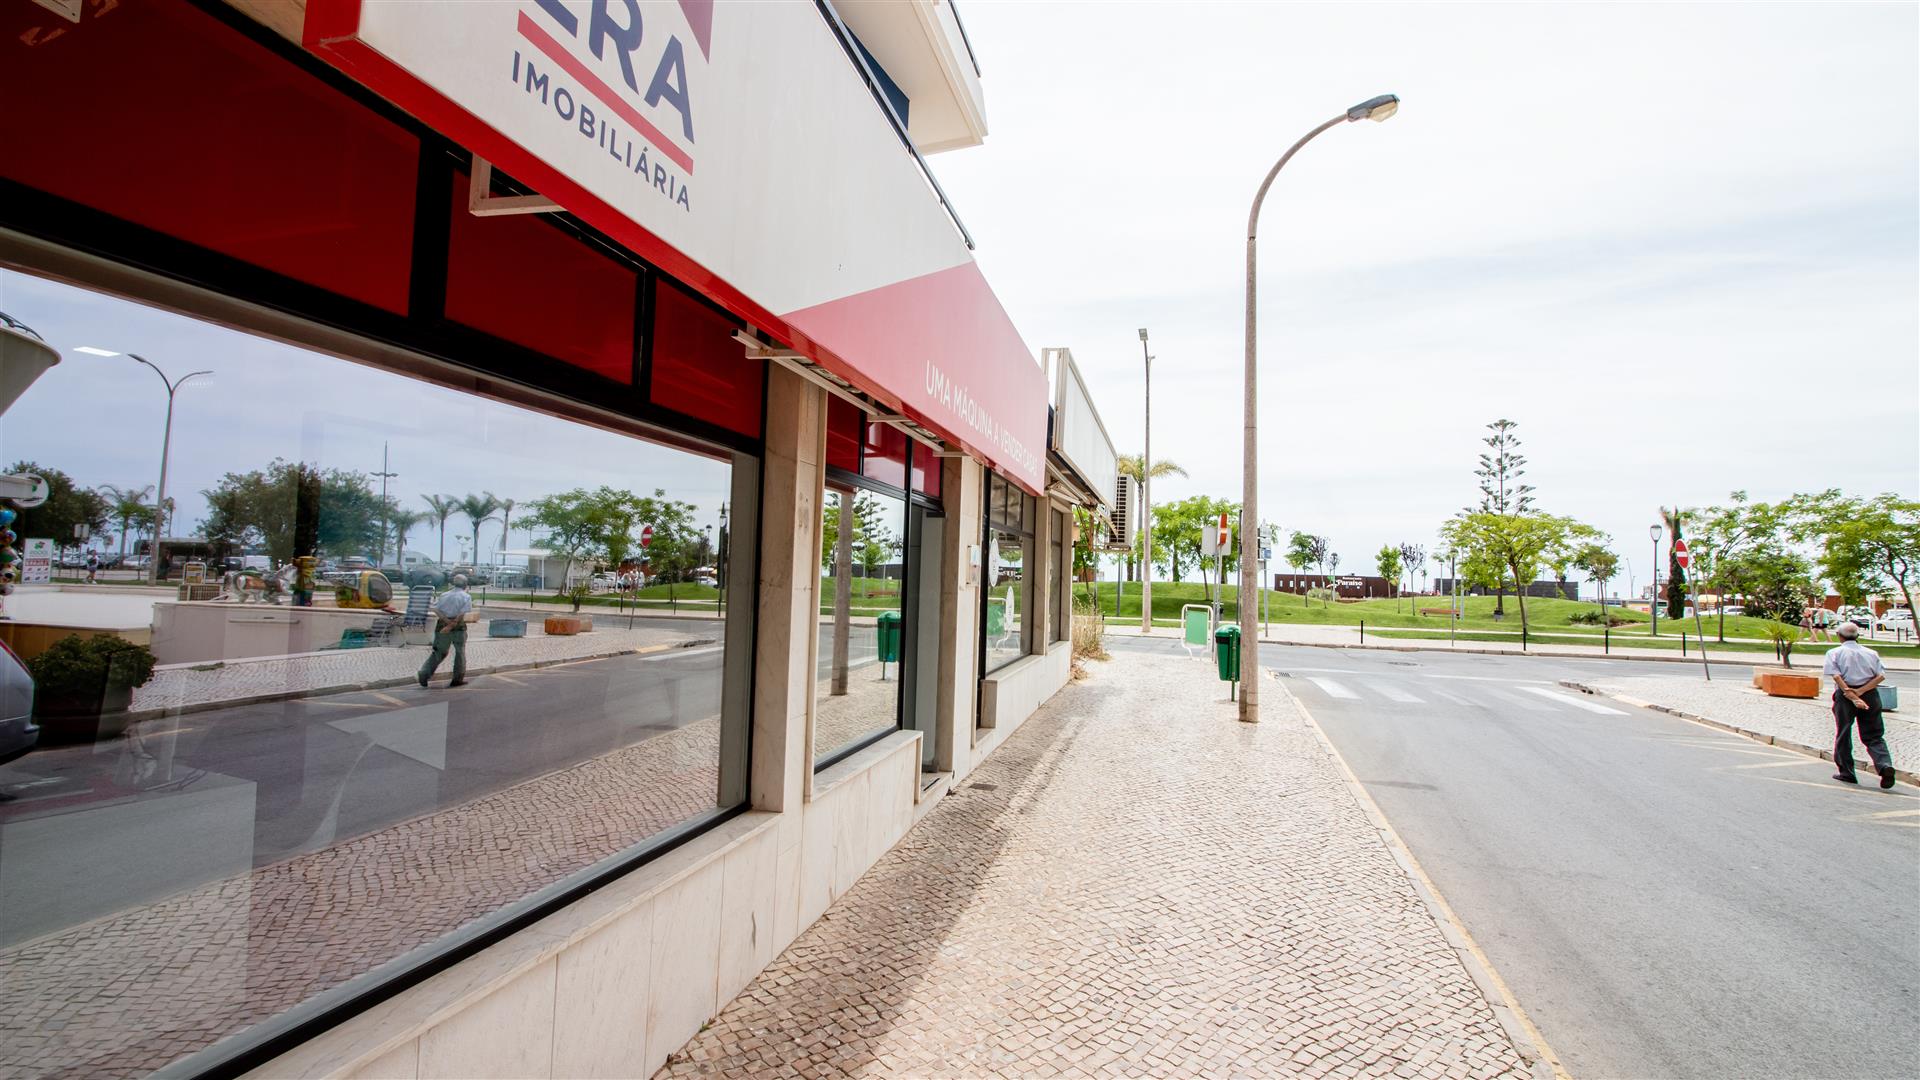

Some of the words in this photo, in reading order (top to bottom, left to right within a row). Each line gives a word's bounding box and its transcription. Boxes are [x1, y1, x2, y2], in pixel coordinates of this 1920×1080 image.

[511, 49, 691, 213] IMOBILIÁRIA
[533, 0, 695, 144] RA
[925, 359, 951, 410] UMA
[953, 384, 993, 441] MÁQUINA
[993, 422, 1000, 446] A
